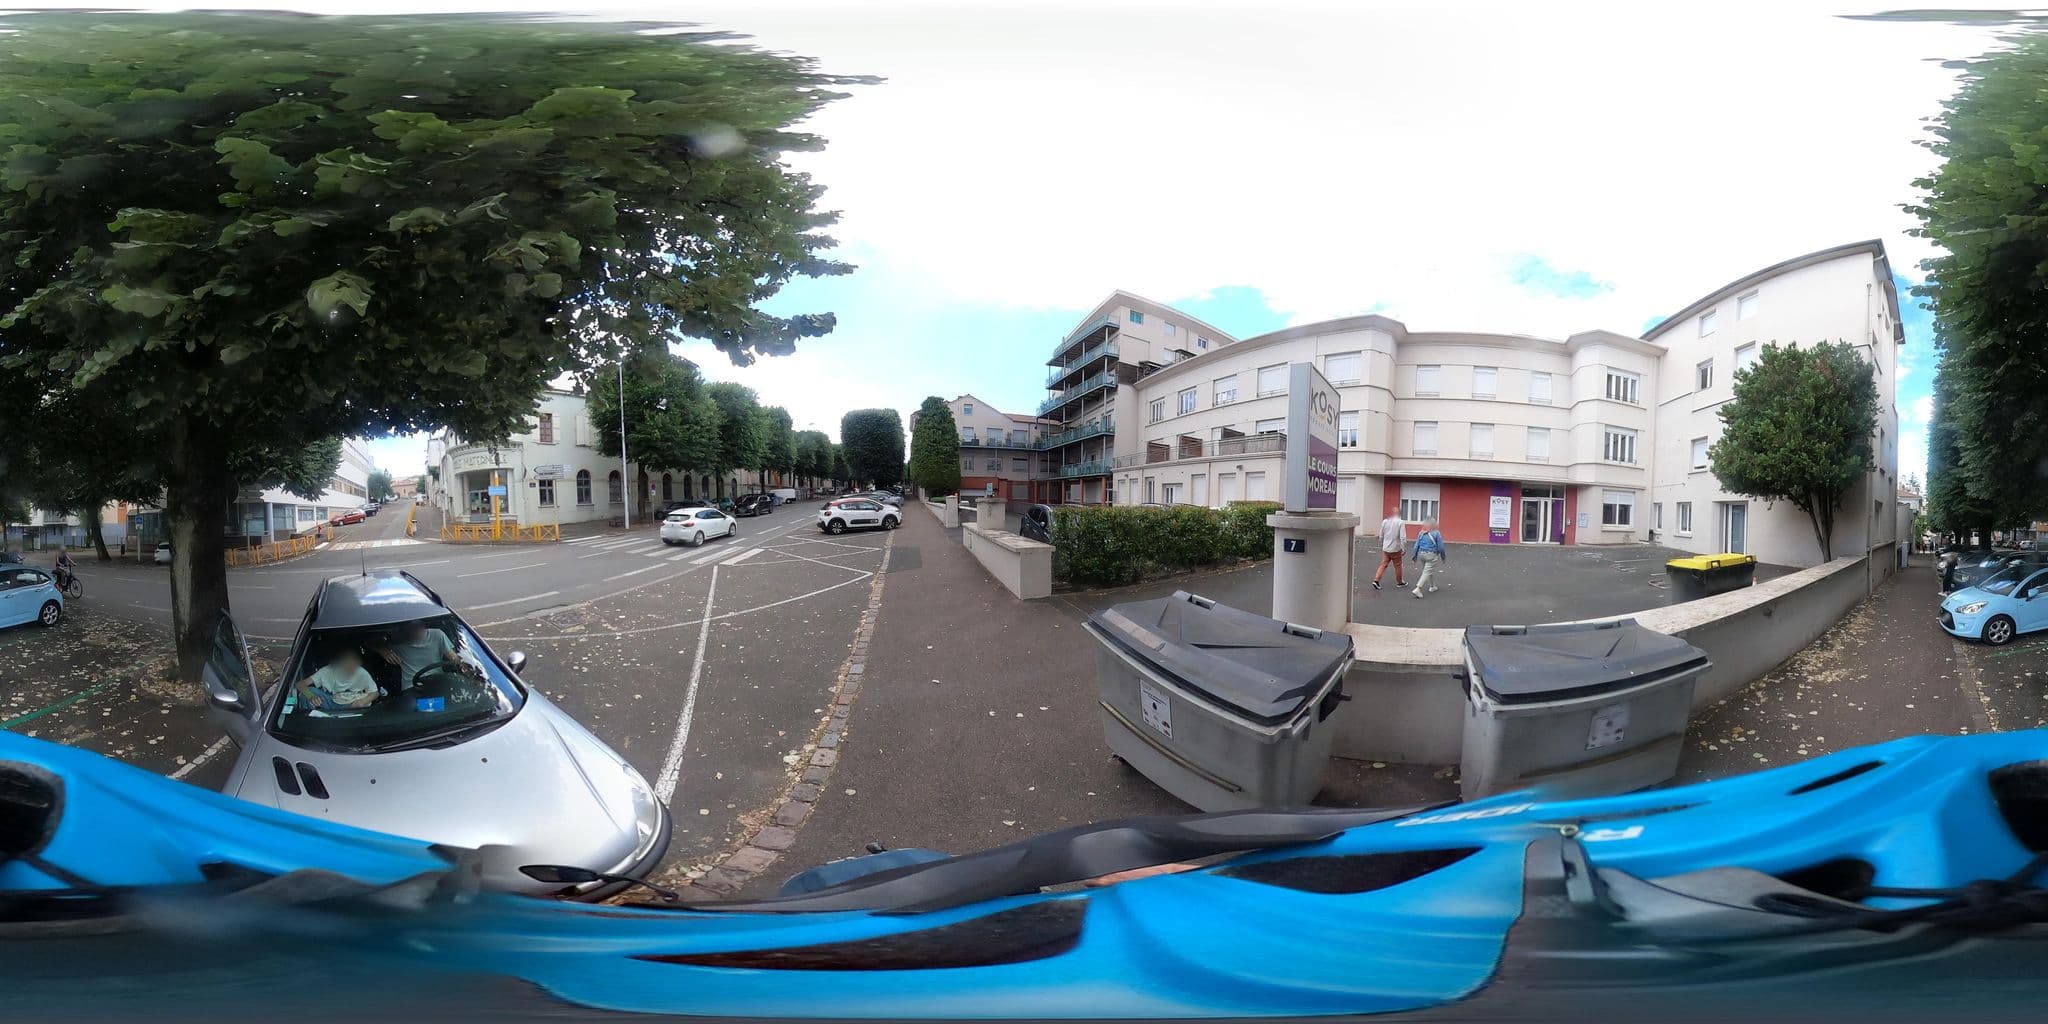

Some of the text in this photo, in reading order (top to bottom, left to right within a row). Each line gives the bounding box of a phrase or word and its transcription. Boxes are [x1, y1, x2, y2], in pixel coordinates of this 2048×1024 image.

[1310, 388, 1339, 429] KOSY
[1308, 455, 1337, 477] LE COURS
[1307, 476, 1337, 495] MOREAU
[1290, 540, 1297, 551] 7
